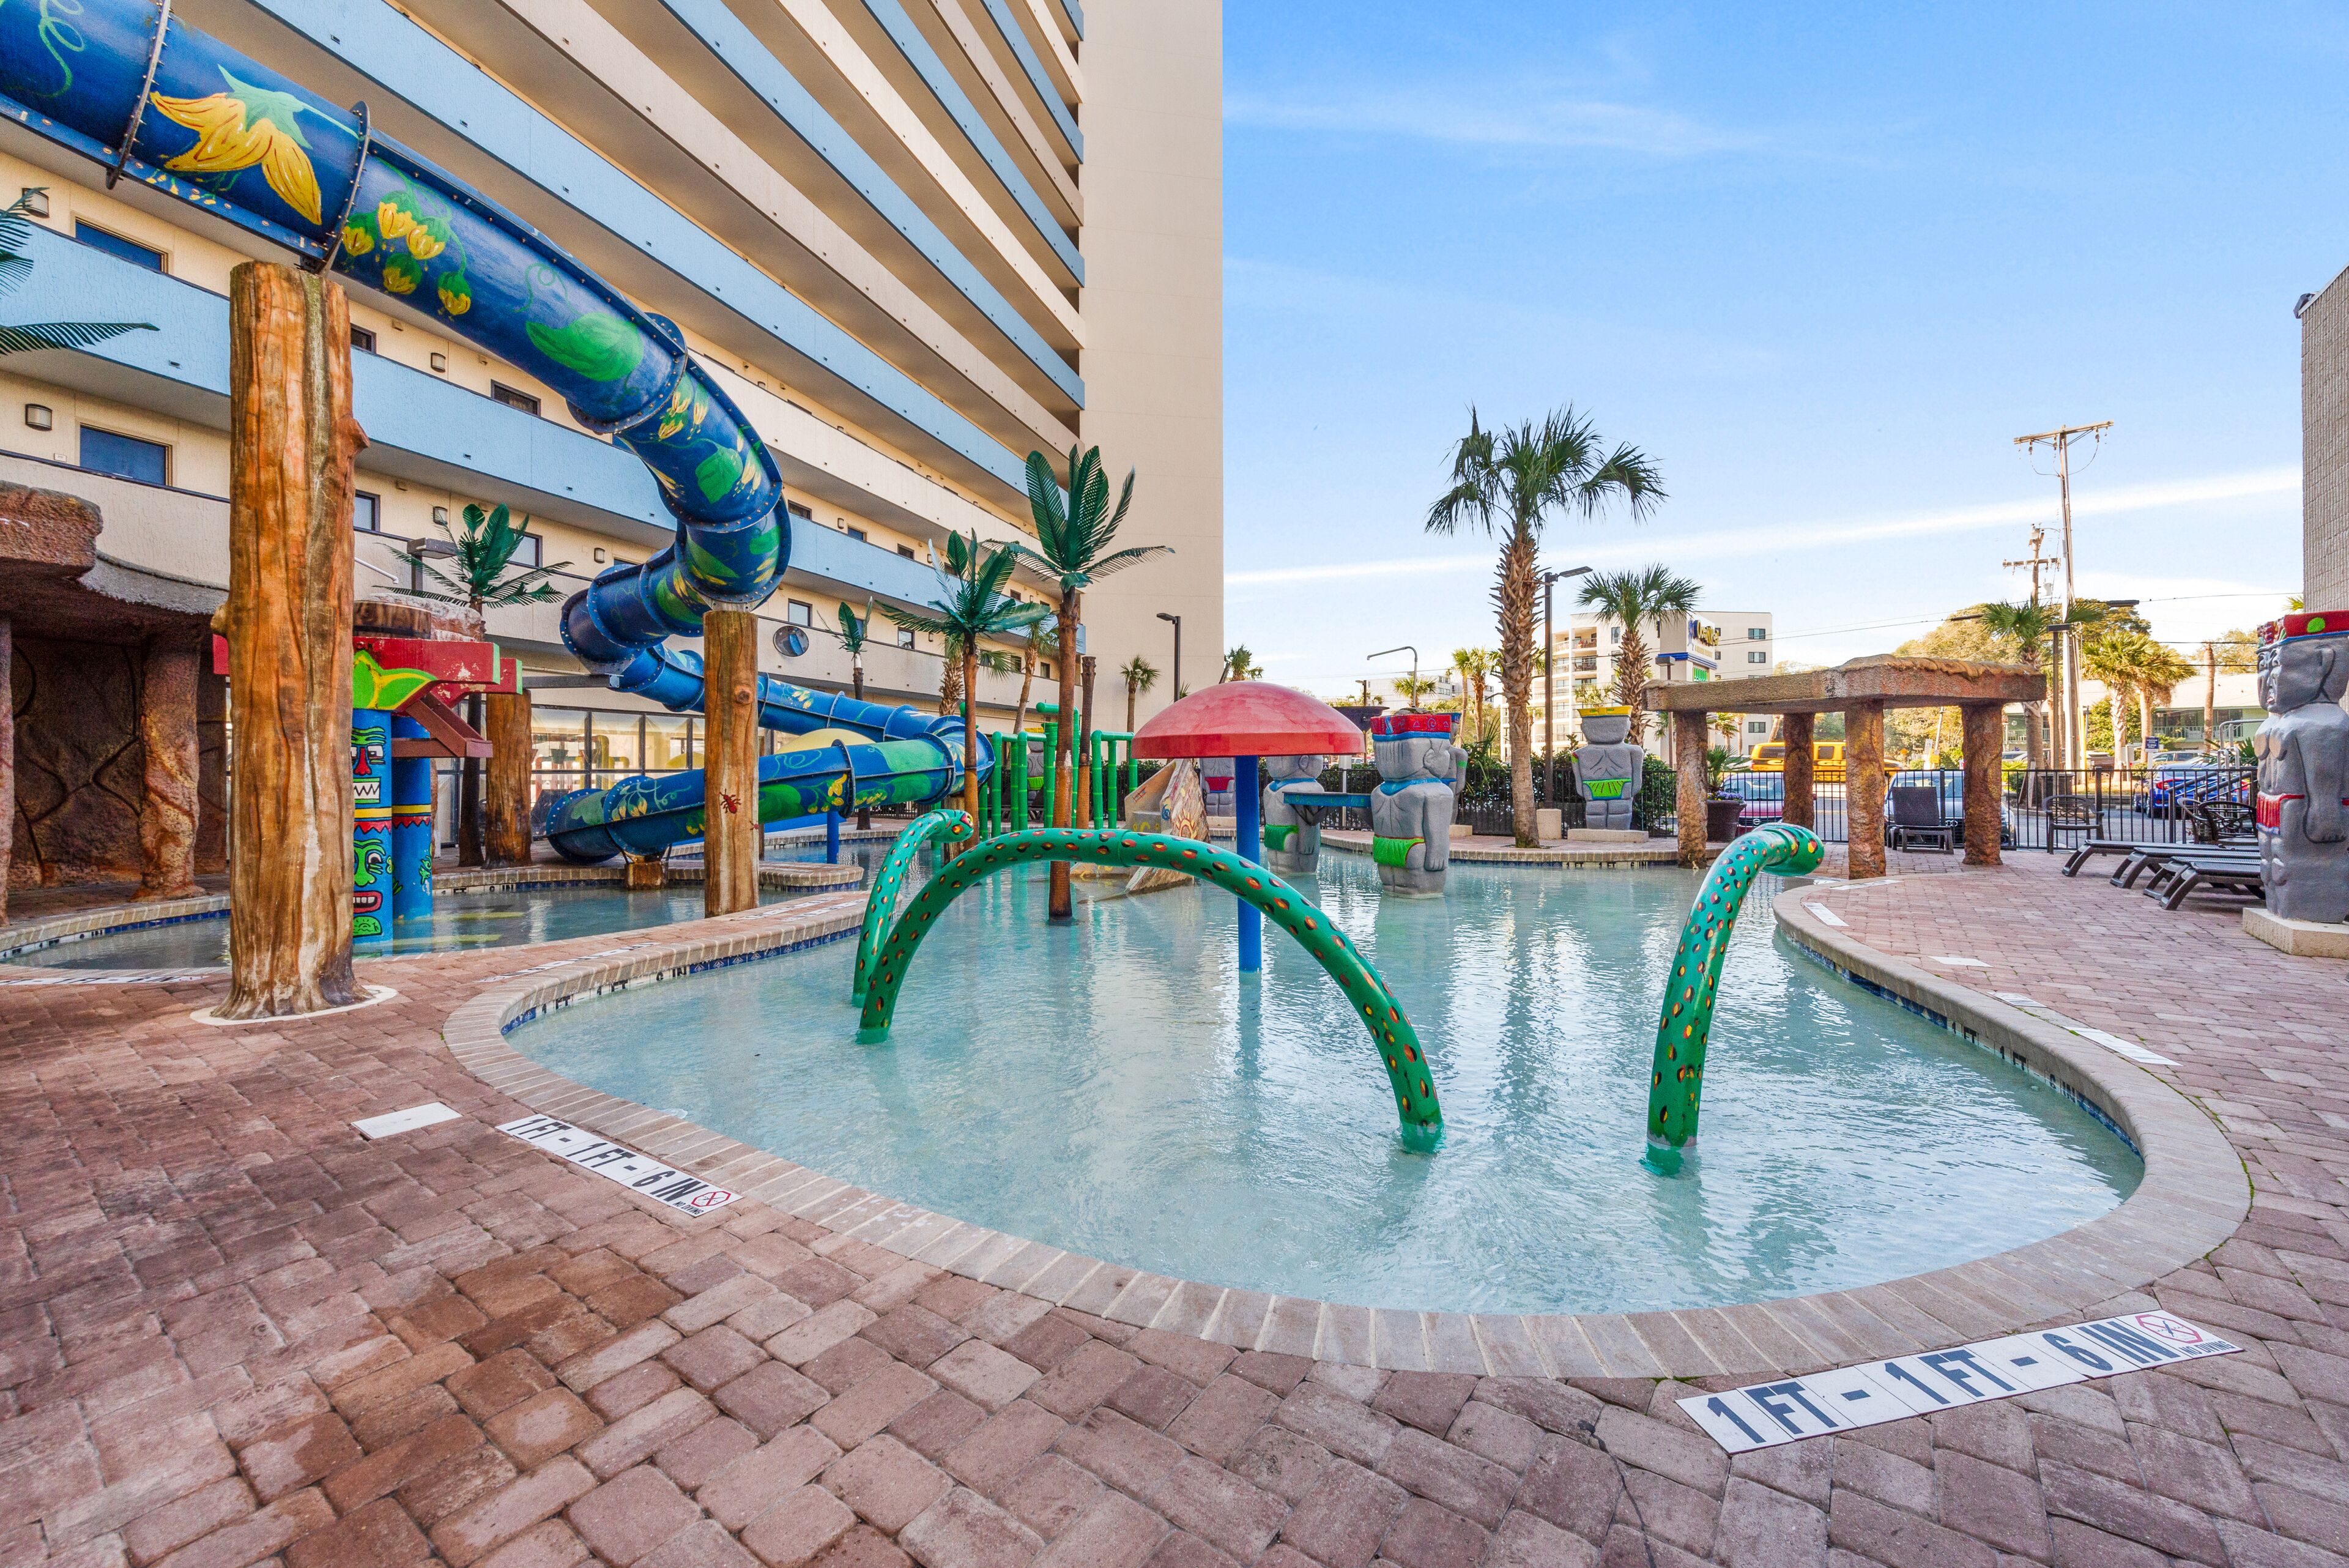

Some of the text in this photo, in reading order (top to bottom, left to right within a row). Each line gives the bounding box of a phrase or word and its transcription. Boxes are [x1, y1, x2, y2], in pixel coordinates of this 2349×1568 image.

[555, 995, 571, 1009] FT
[611, 979, 628, 992] FT
[1964, 1026, 1977, 1044] FT
[2013, 1051, 2027, 1071] FT
[518, 1121, 573, 1139] FT
[579, 1148, 637, 1168] FT
[632, 1170, 676, 1187] 6
[649, 1178, 709, 1202] IN
[681, 1204, 705, 1215] DIVING
[2042, 1333, 2113, 1371] 6
[2077, 1321, 2181, 1364] IN
[2178, 1340, 2236, 1356] NO DIVING
[1917, 1349, 2017, 1397] FT
[1744, 1381, 1839, 1435] FT
